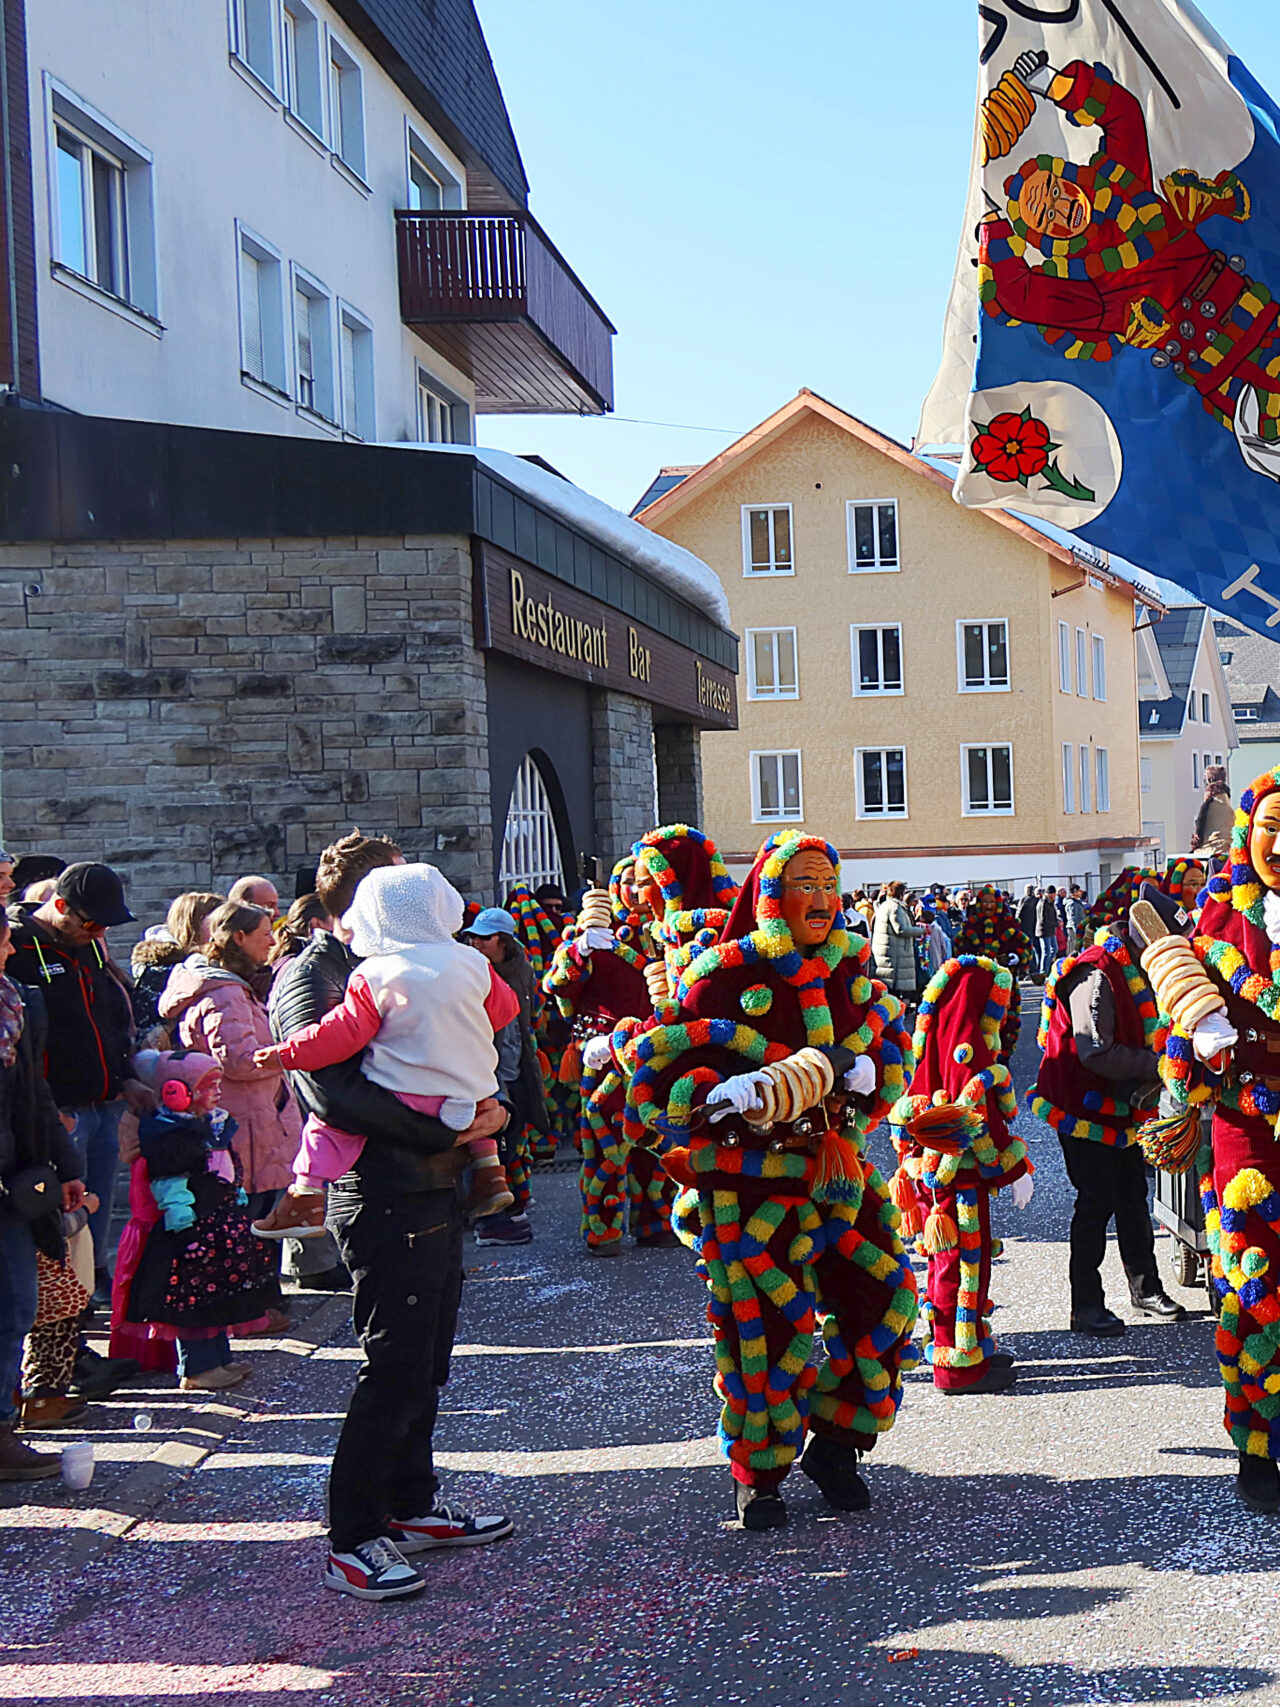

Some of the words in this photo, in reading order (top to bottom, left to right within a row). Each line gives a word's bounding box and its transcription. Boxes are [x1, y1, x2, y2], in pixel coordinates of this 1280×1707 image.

[510, 568, 609, 669] Restaurant
[627, 626, 651, 683] Bar
[695, 660, 731, 714] Terrasse
